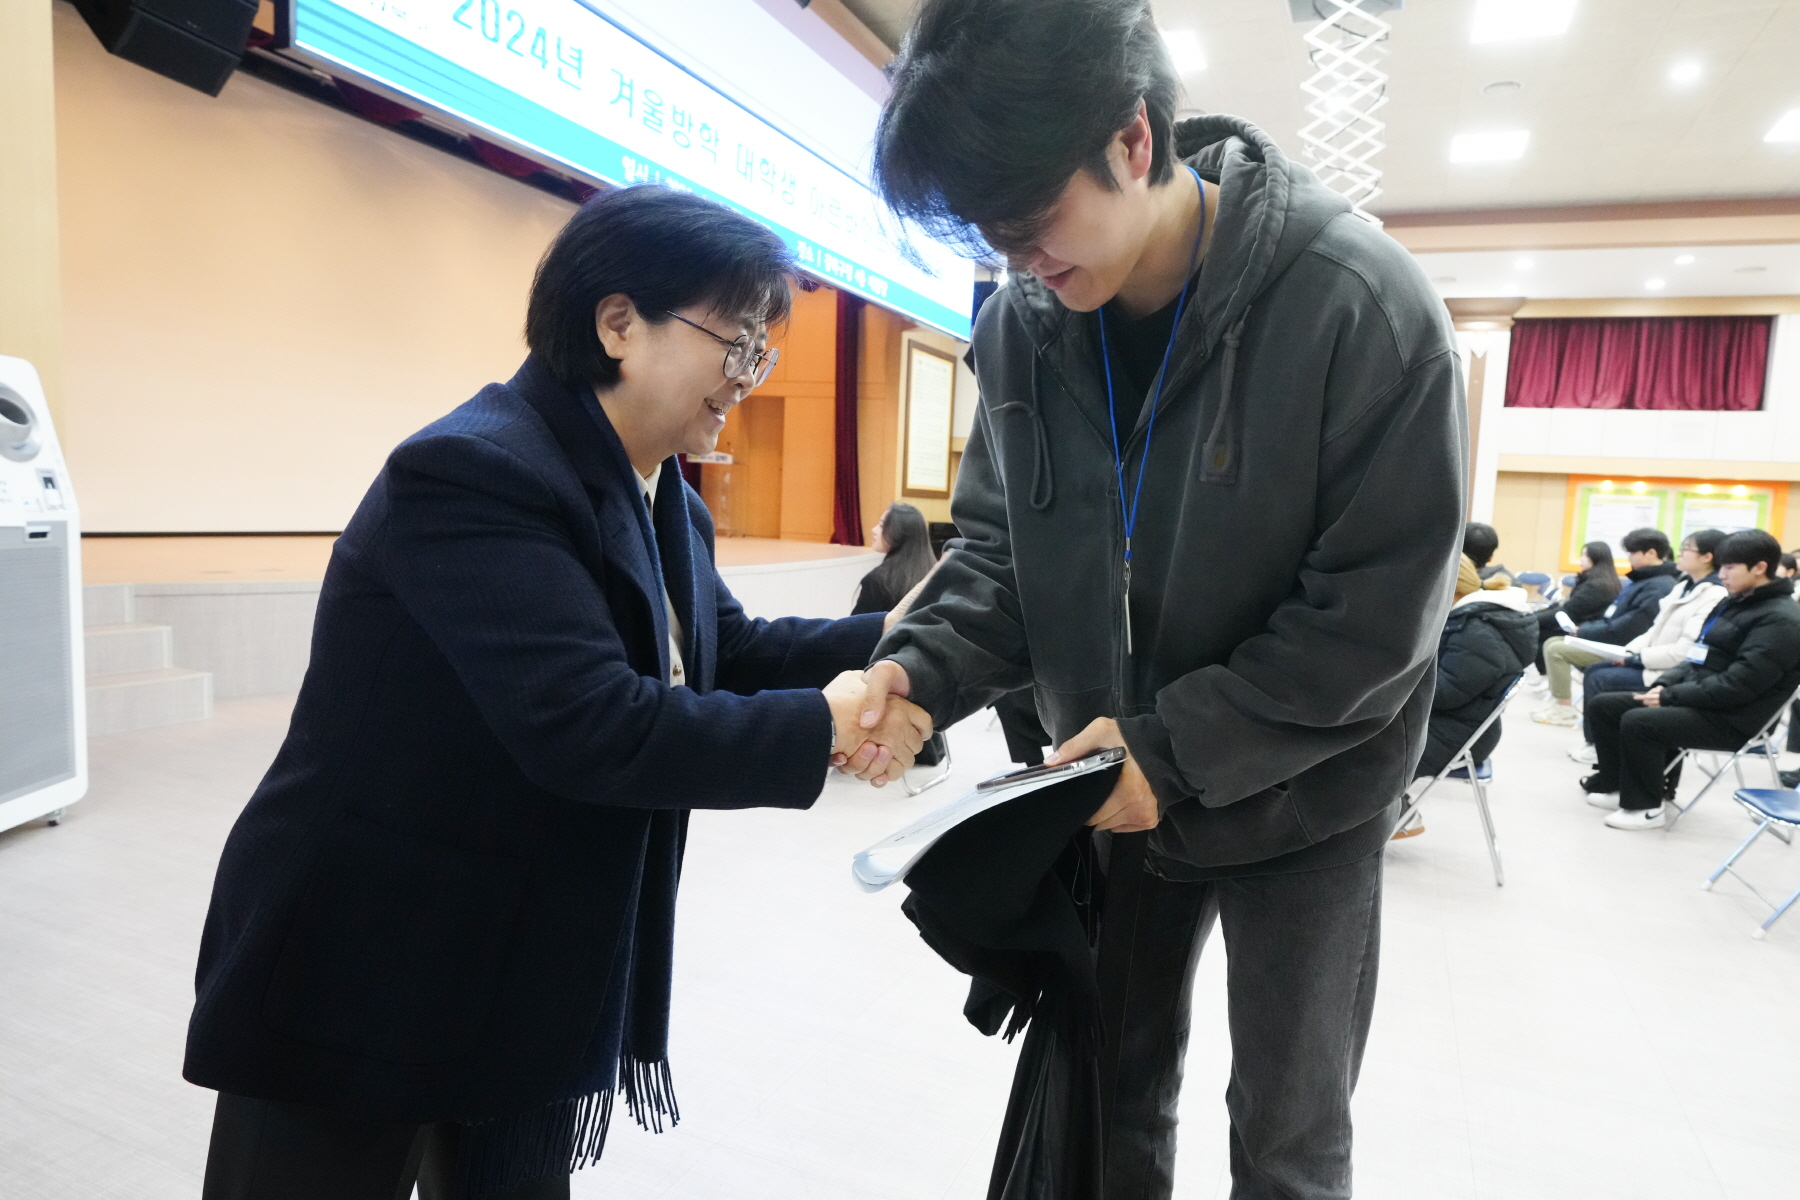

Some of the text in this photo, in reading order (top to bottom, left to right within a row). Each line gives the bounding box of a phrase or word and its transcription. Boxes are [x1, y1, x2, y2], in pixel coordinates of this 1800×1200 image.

[452, 0, 582, 91] 2024년
[609, 67, 720, 164] 겨울방학
[736, 142, 797, 206] 대학생
[809, 186, 887, 254] 아르바이
